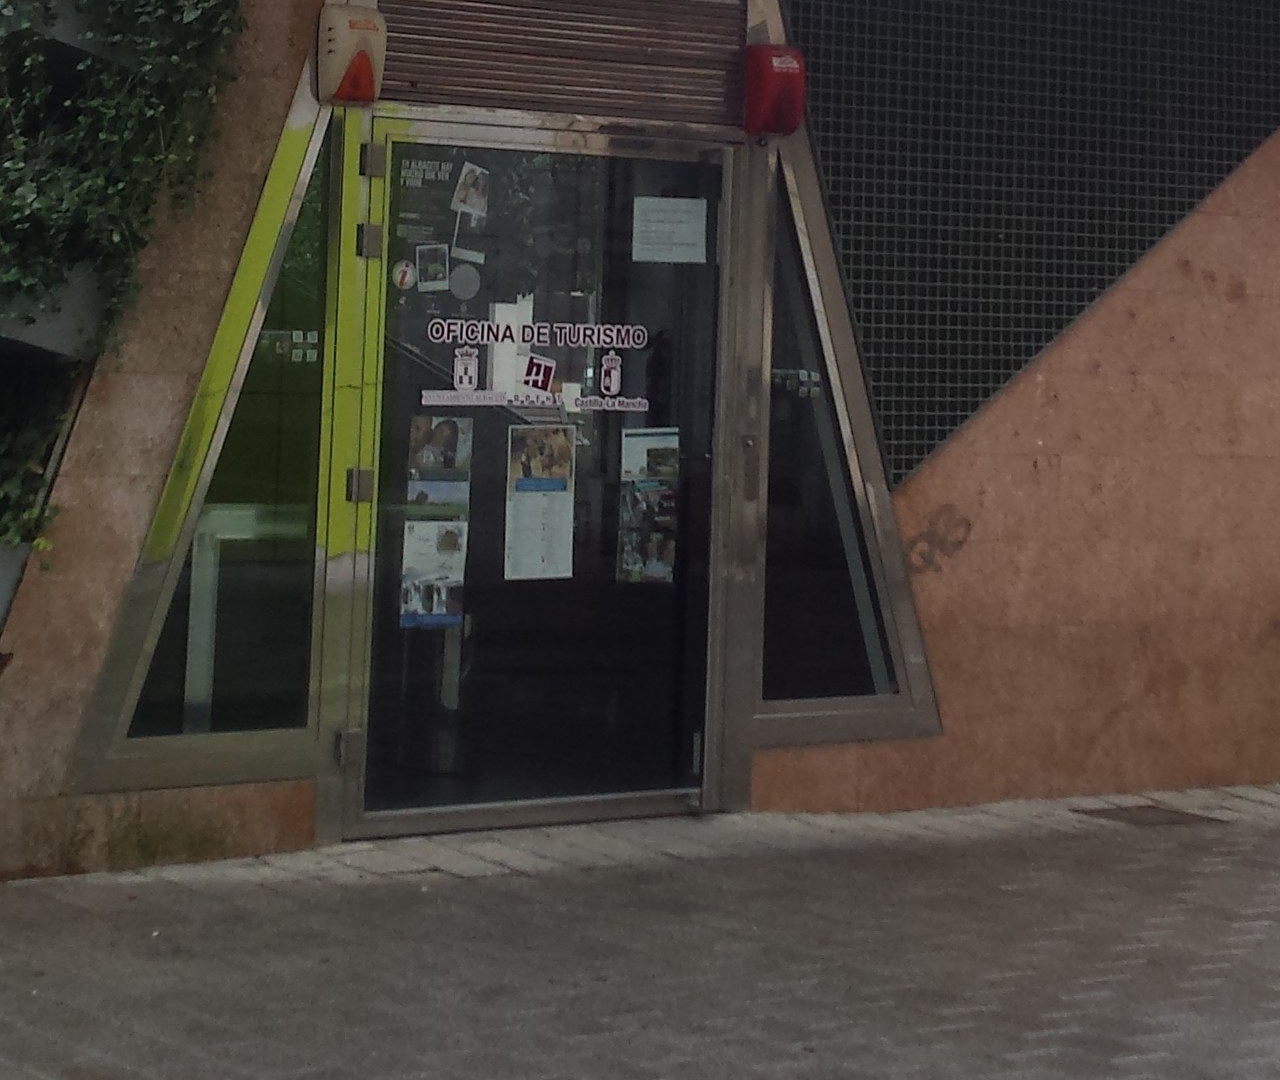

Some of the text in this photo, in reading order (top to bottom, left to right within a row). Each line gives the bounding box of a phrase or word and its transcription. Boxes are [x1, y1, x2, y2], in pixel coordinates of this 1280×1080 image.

[429, 321, 648, 347] OFICINA DE TURISMO
